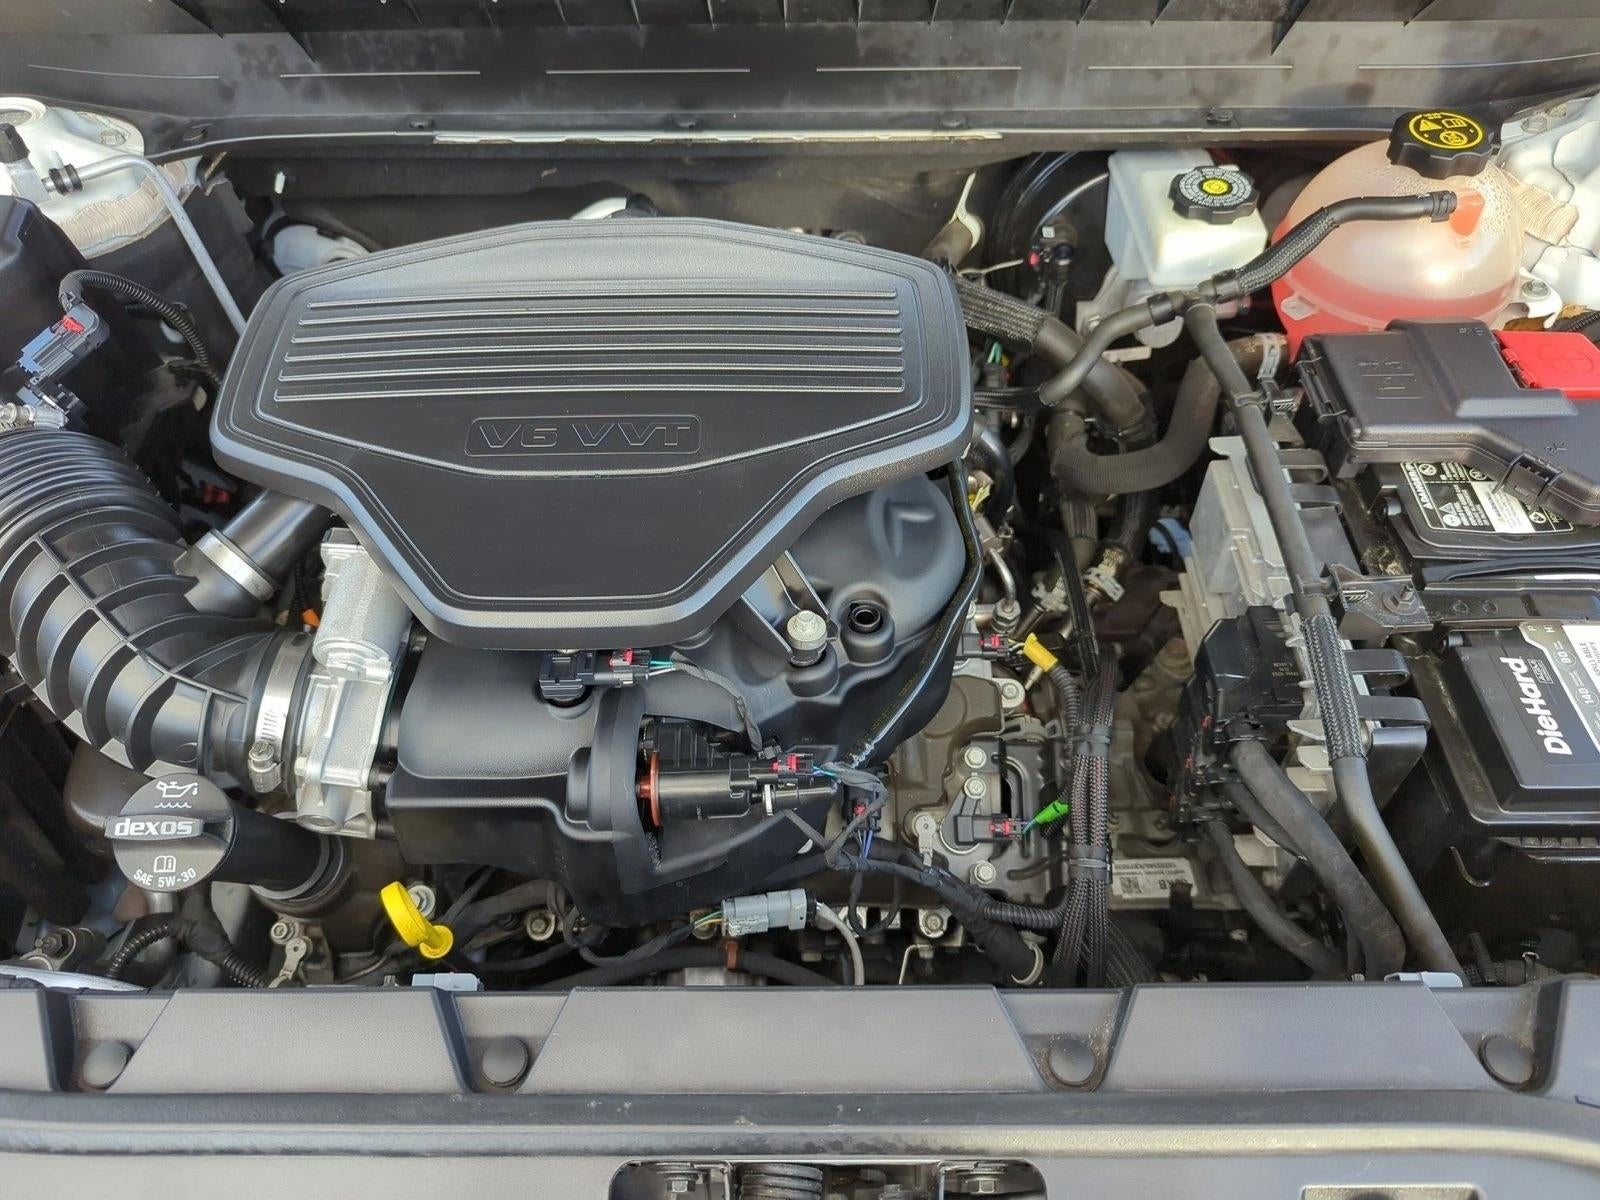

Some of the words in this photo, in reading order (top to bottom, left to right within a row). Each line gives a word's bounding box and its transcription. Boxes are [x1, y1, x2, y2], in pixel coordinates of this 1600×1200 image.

[479, 424, 558, 448] V6
[572, 422, 691, 446] VVT
[1500, 656, 1573, 755] DieHard
[1578, 687, 1595, 704] 140
[114, 818, 194, 837] dexos
[133, 868, 154, 886] SAE
[157, 867, 197, 888] 5W-30
